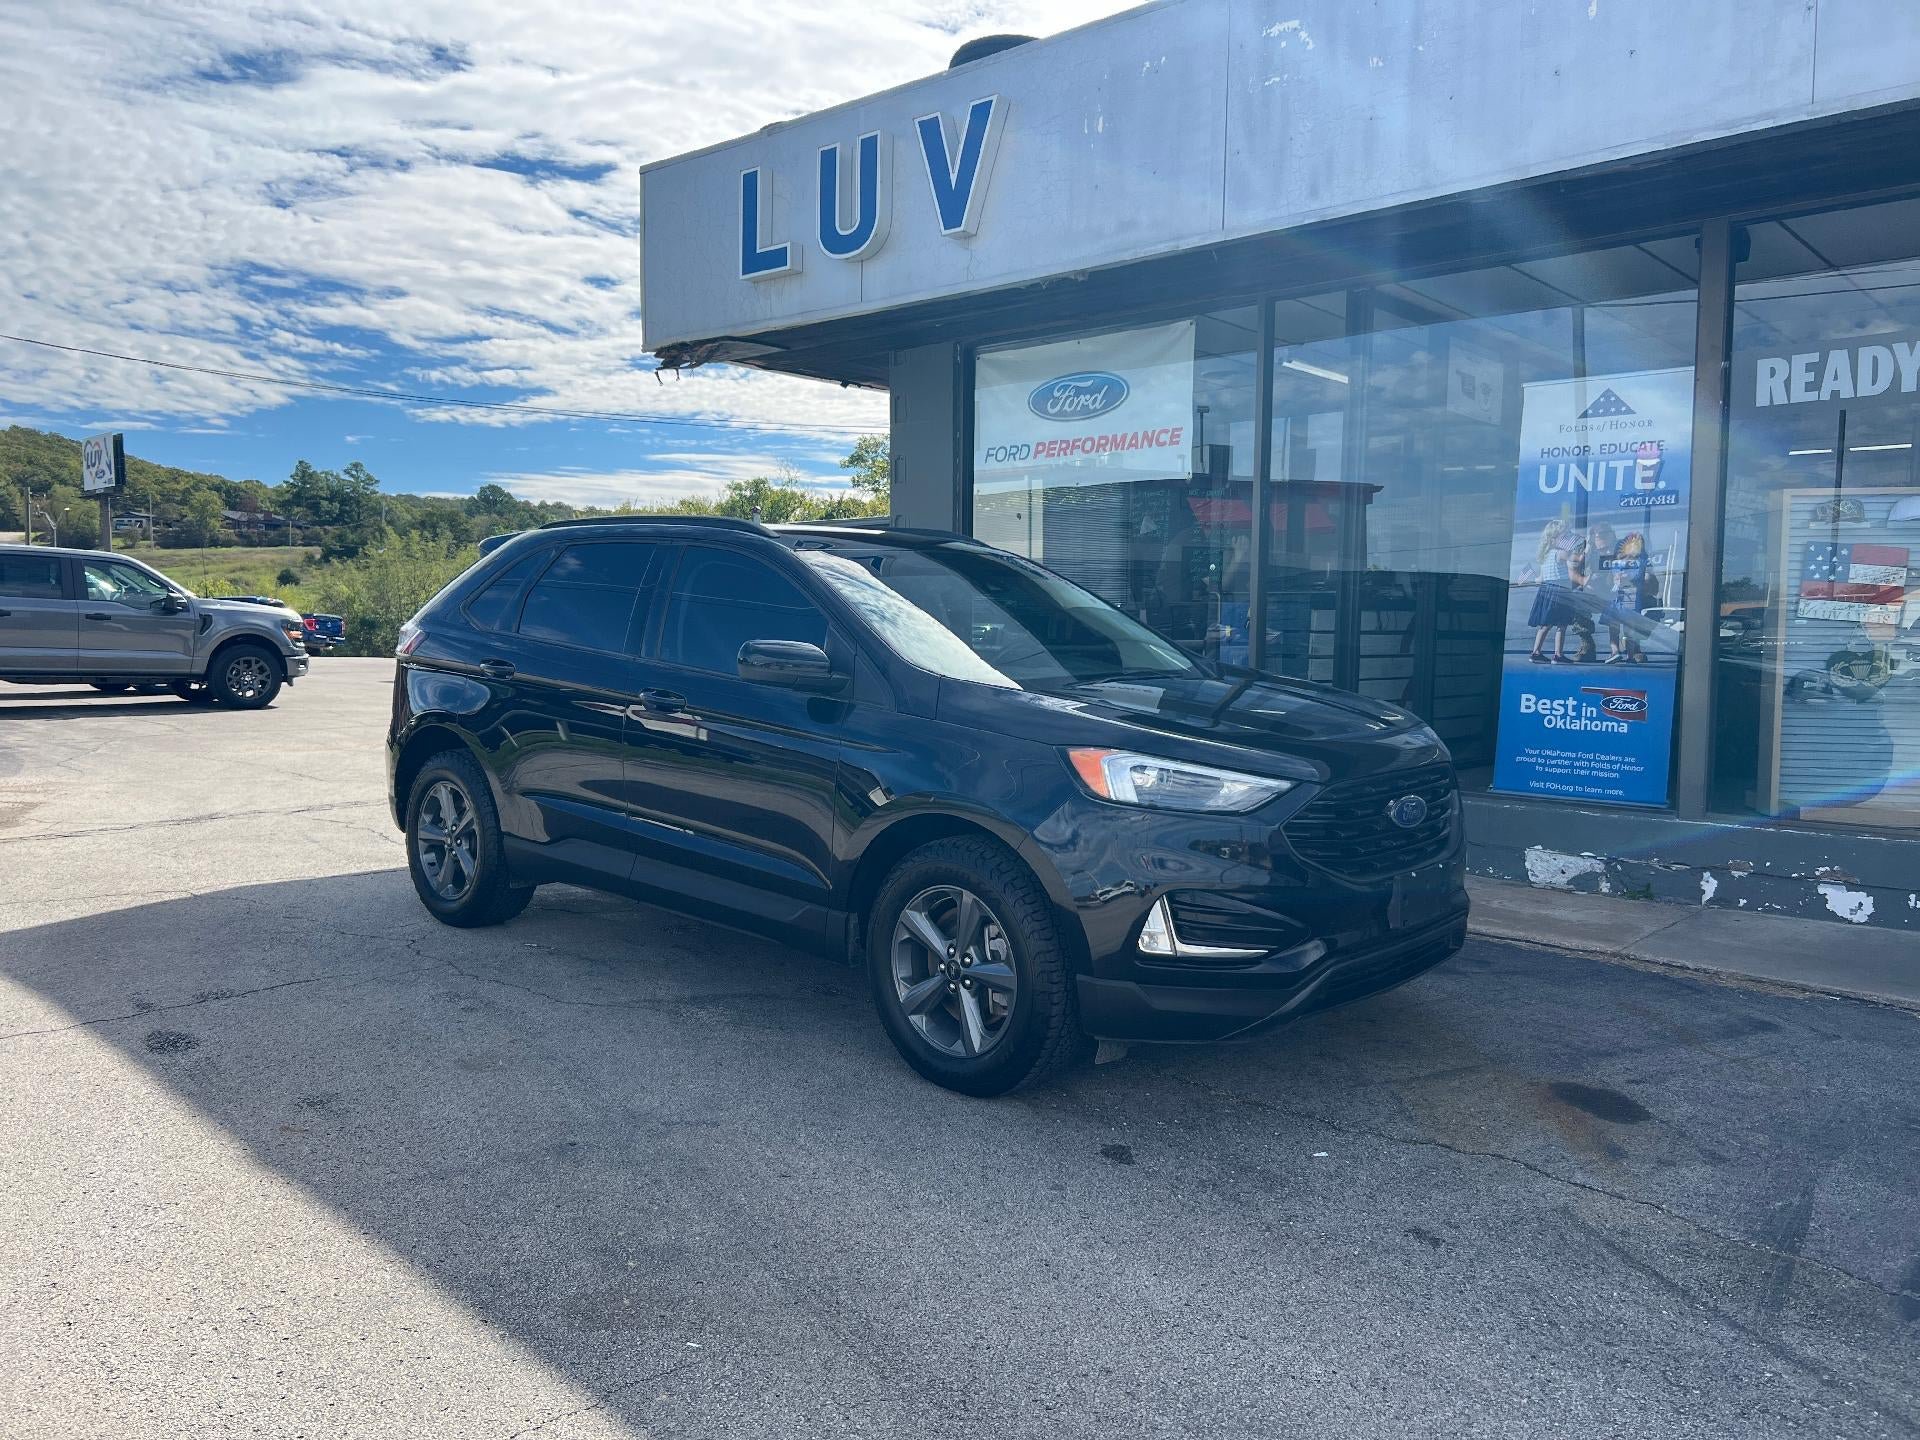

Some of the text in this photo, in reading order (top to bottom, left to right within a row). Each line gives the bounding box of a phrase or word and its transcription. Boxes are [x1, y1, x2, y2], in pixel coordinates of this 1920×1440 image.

[739, 94, 1000, 280] LUV
[1755, 340, 1920, 407] READY
[1047, 379, 1109, 414] Ford
[984, 426, 1184, 464] FORD PERFORMANCE
[1540, 440, 1668, 459] HONOR. EDUCATE.
[1538, 459, 1666, 494] UNITE.
[1519, 693, 1597, 718] Best in
[1609, 698, 1639, 711] Ford
[1543, 715, 1629, 734] Oklahoma
[1515, 756, 1537, 764] proud
[1546, 758, 1572, 766] partner
[1573, 759, 1590, 768] with
[1590, 761, 1611, 770] Folds
[1611, 763, 1620, 771] of
[1621, 764, 1645, 772] Honor
[1524, 747, 1540, 755] Your
[1541, 749, 1576, 758] Oklahoma
[1577, 751, 1594, 760] Ford
[1595, 753, 1623, 762] Dealers
[1544, 767, 1572, 776] support
[1573, 768, 1590, 776] their
[1529, 780, 1544, 789] Visit
[1584, 785, 1602, 794] learn
[1604, 788, 1625, 797] more.
